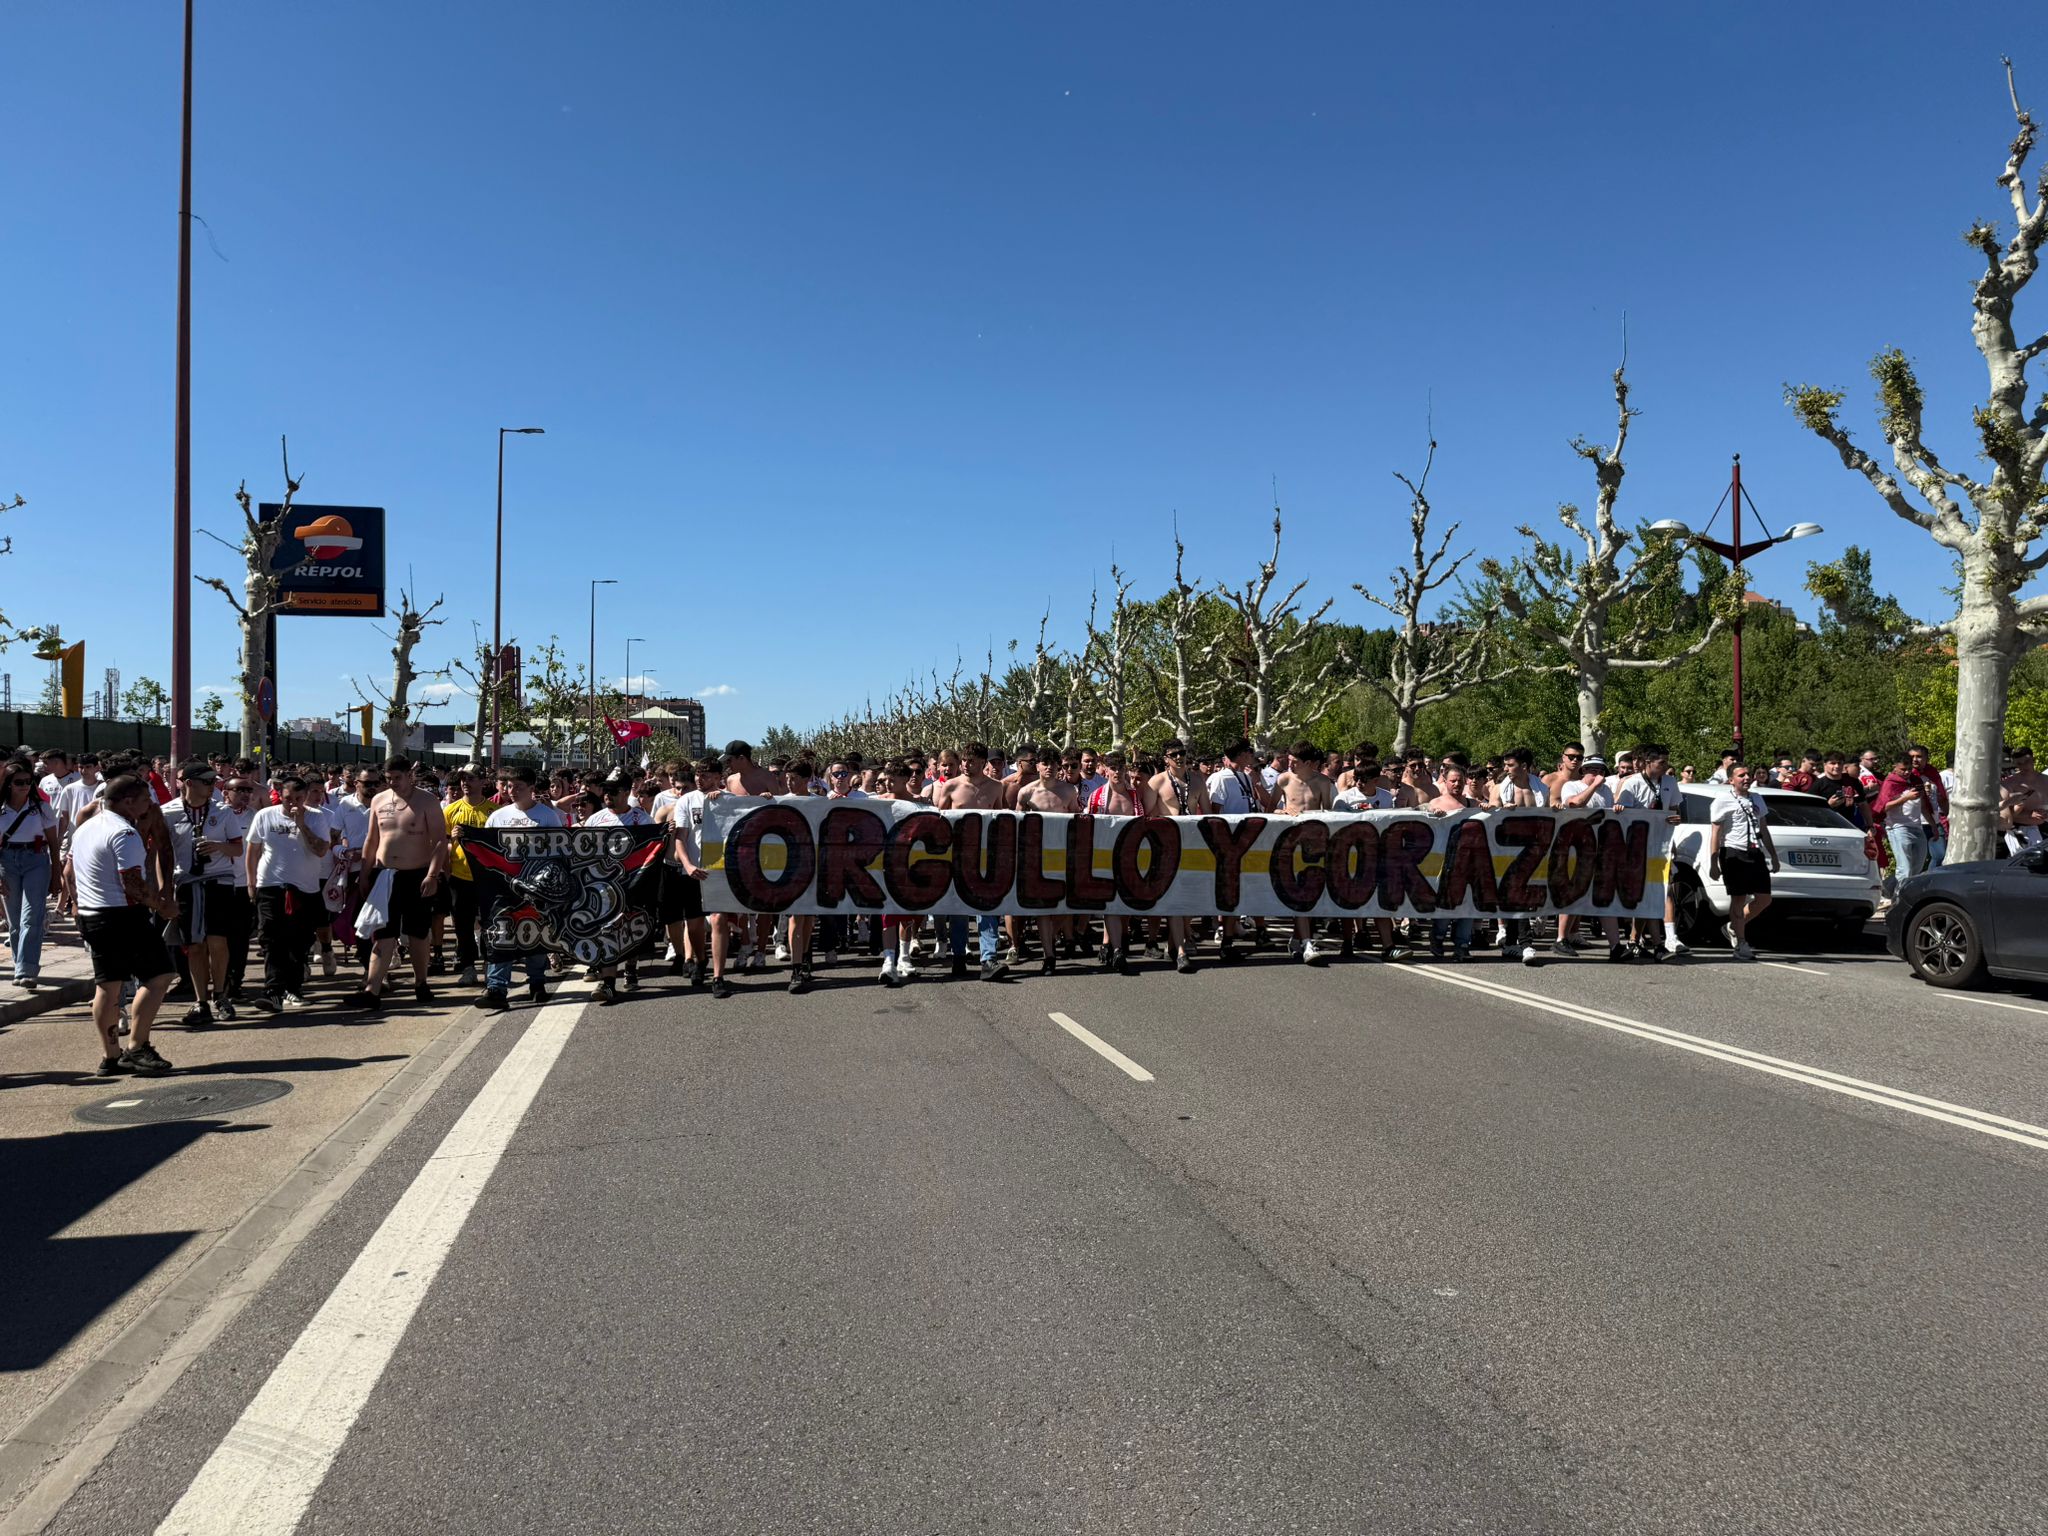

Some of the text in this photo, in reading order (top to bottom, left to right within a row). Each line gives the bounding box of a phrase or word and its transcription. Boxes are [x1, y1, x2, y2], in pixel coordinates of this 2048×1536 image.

[294, 565, 364, 578] REPSOL
[501, 831, 632, 858] TERCIO
[724, 803, 1182, 911] ORGULLO
[1198, 816, 1267, 912] Y
[1796, 853, 1820, 864] 9123
